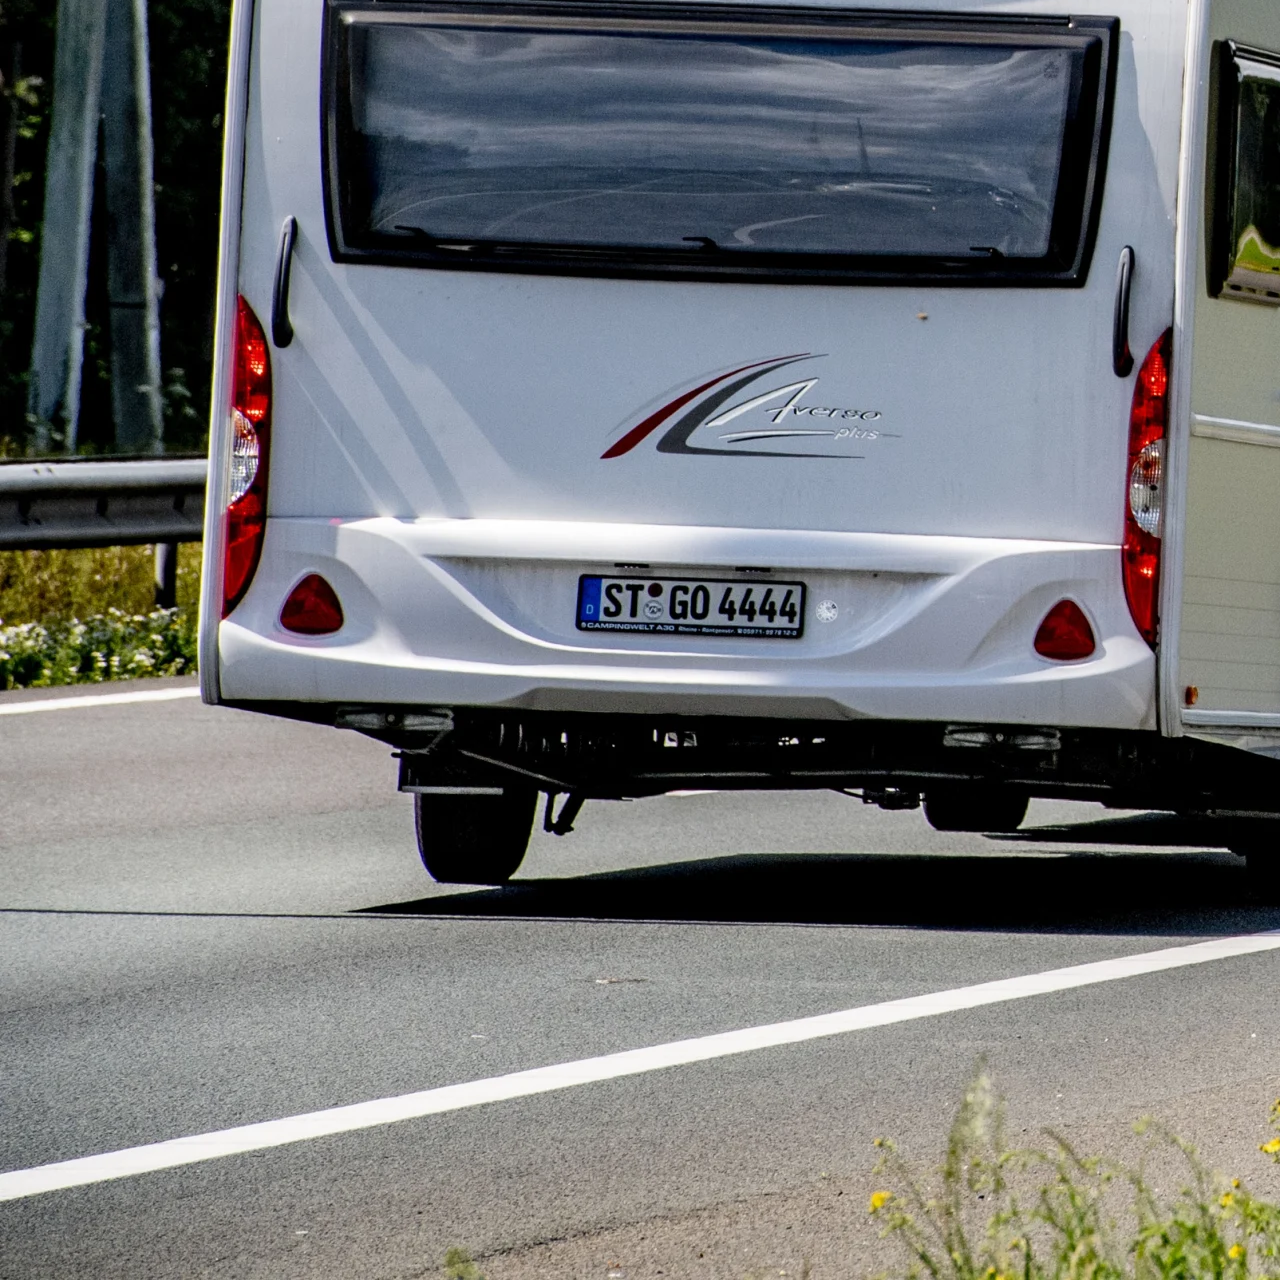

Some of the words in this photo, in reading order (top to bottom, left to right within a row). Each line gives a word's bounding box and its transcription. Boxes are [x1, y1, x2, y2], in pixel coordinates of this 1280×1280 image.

[705, 377, 882, 424] Averso
[834, 425, 880, 441] plus
[603, 583, 645, 618] ST
[669, 584, 710, 620] GO
[718, 587, 797, 624] 4444
[587, 622, 655, 631] CAMPINGWELT
